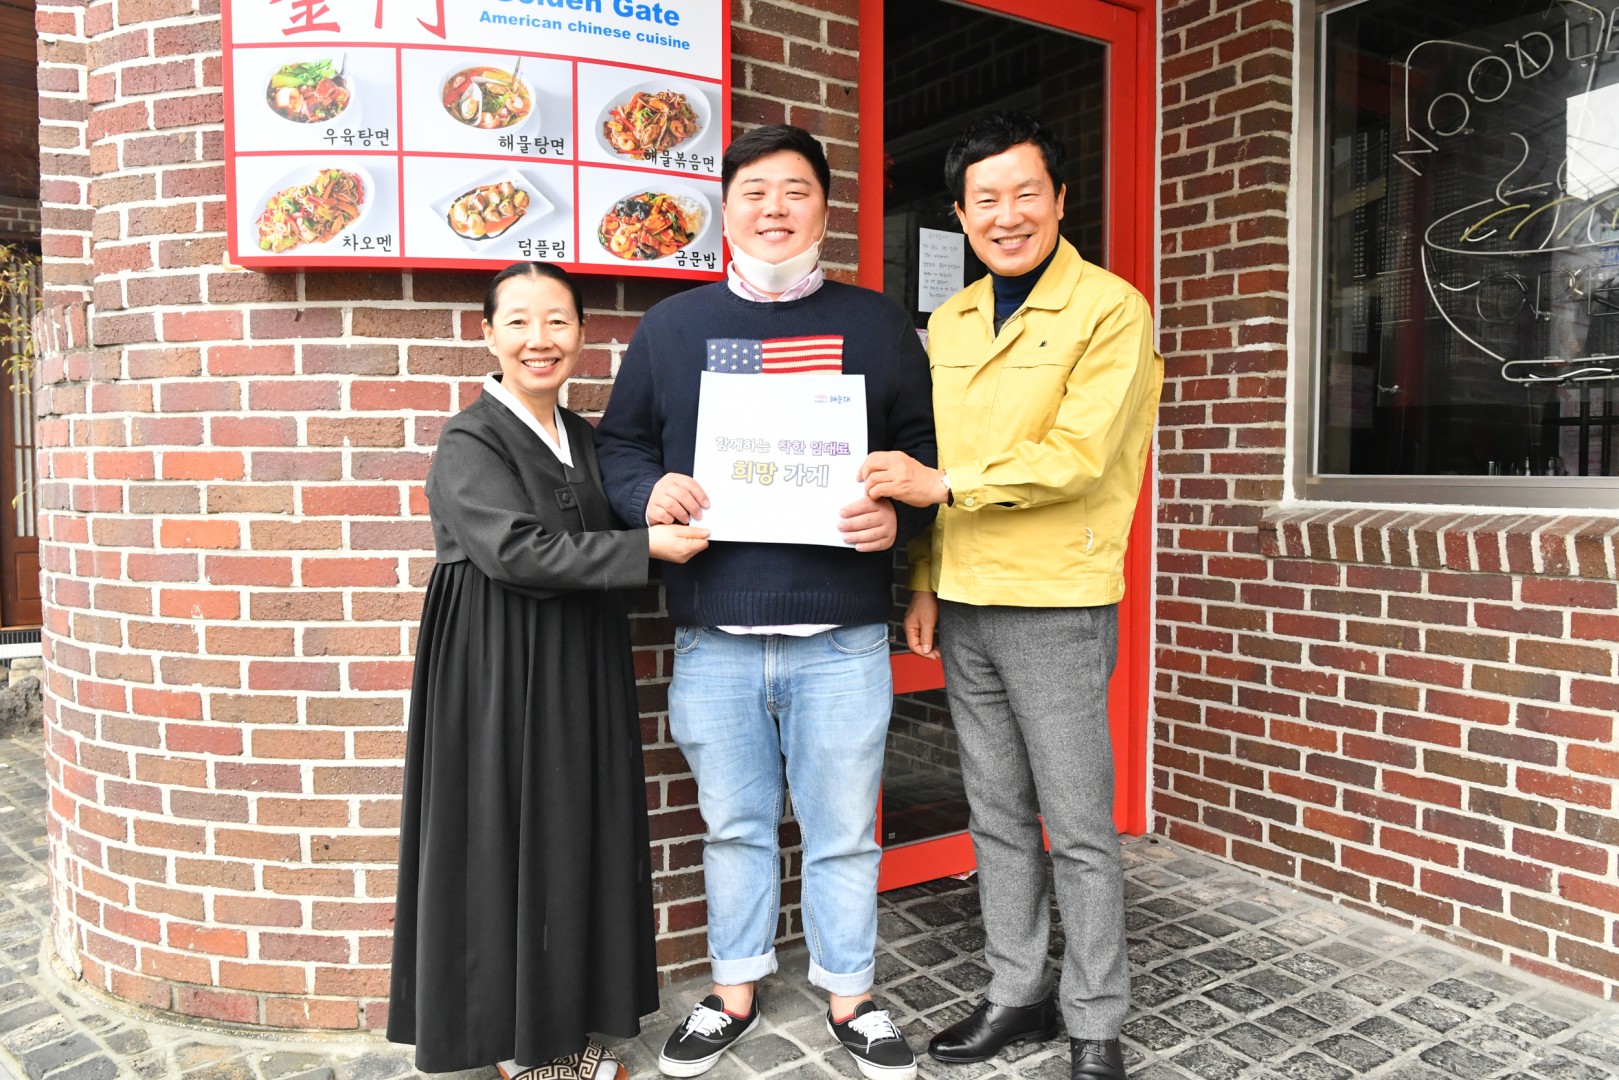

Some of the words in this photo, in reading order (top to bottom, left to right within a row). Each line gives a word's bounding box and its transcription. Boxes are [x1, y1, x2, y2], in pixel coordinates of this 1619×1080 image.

[613, 0, 681, 26] Gate
[479, 10, 562, 30] American
[567, 20, 631, 39] chinese
[636, 32, 690, 50] cuisine
[323, 128, 390, 147] 우육탕면
[498, 134, 565, 156] 해물탕면
[644, 147, 714, 173] 해물볶음면
[343, 233, 392, 252] 차오멘
[518, 238, 566, 258] 덤플링
[675, 250, 717, 269] 금문밥
[715, 436, 771, 453] 함께하는
[777, 439, 806, 455] 착한
[810, 441, 851, 456] 임대료
[731, 460, 778, 486] 희망
[784, 463, 829, 487] 가게
